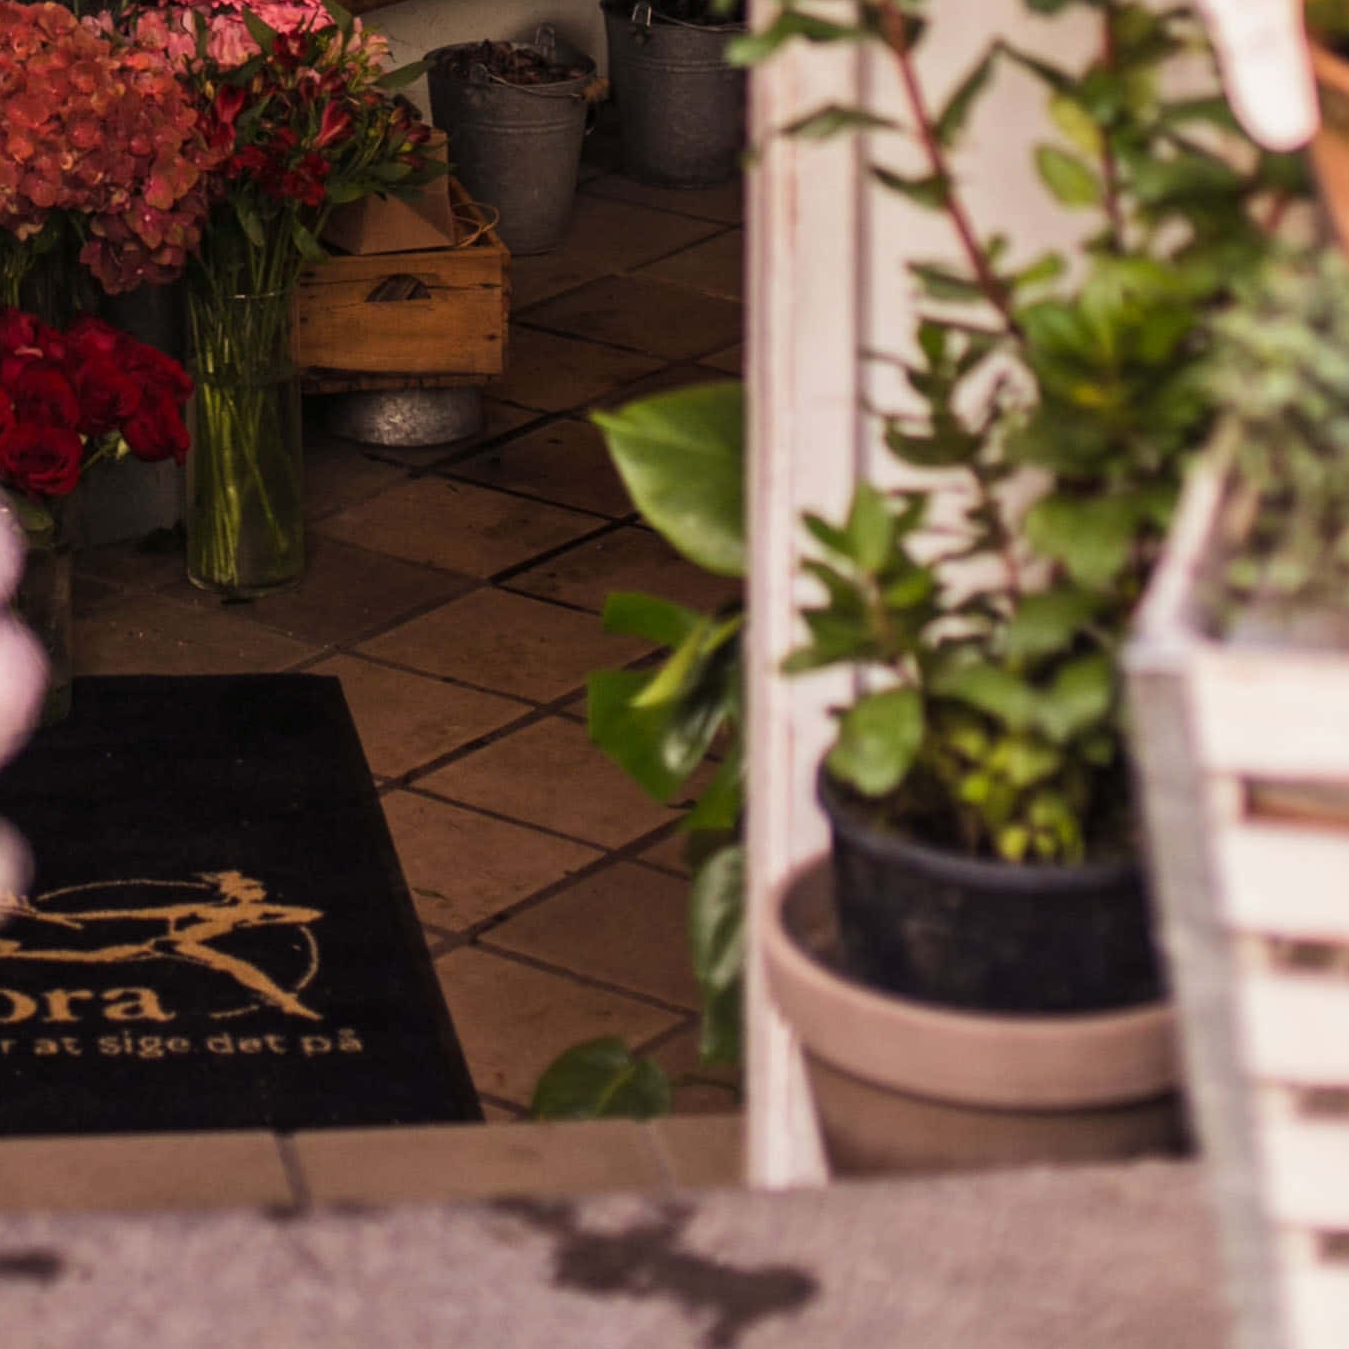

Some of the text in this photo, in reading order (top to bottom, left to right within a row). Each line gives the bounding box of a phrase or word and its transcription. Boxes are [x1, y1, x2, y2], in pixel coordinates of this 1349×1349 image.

[34, 1035, 82, 1057] at
[98, 1029, 191, 1059] sige
[207, 1031, 290, 1056] det
[301, 1028, 365, 1057] på
